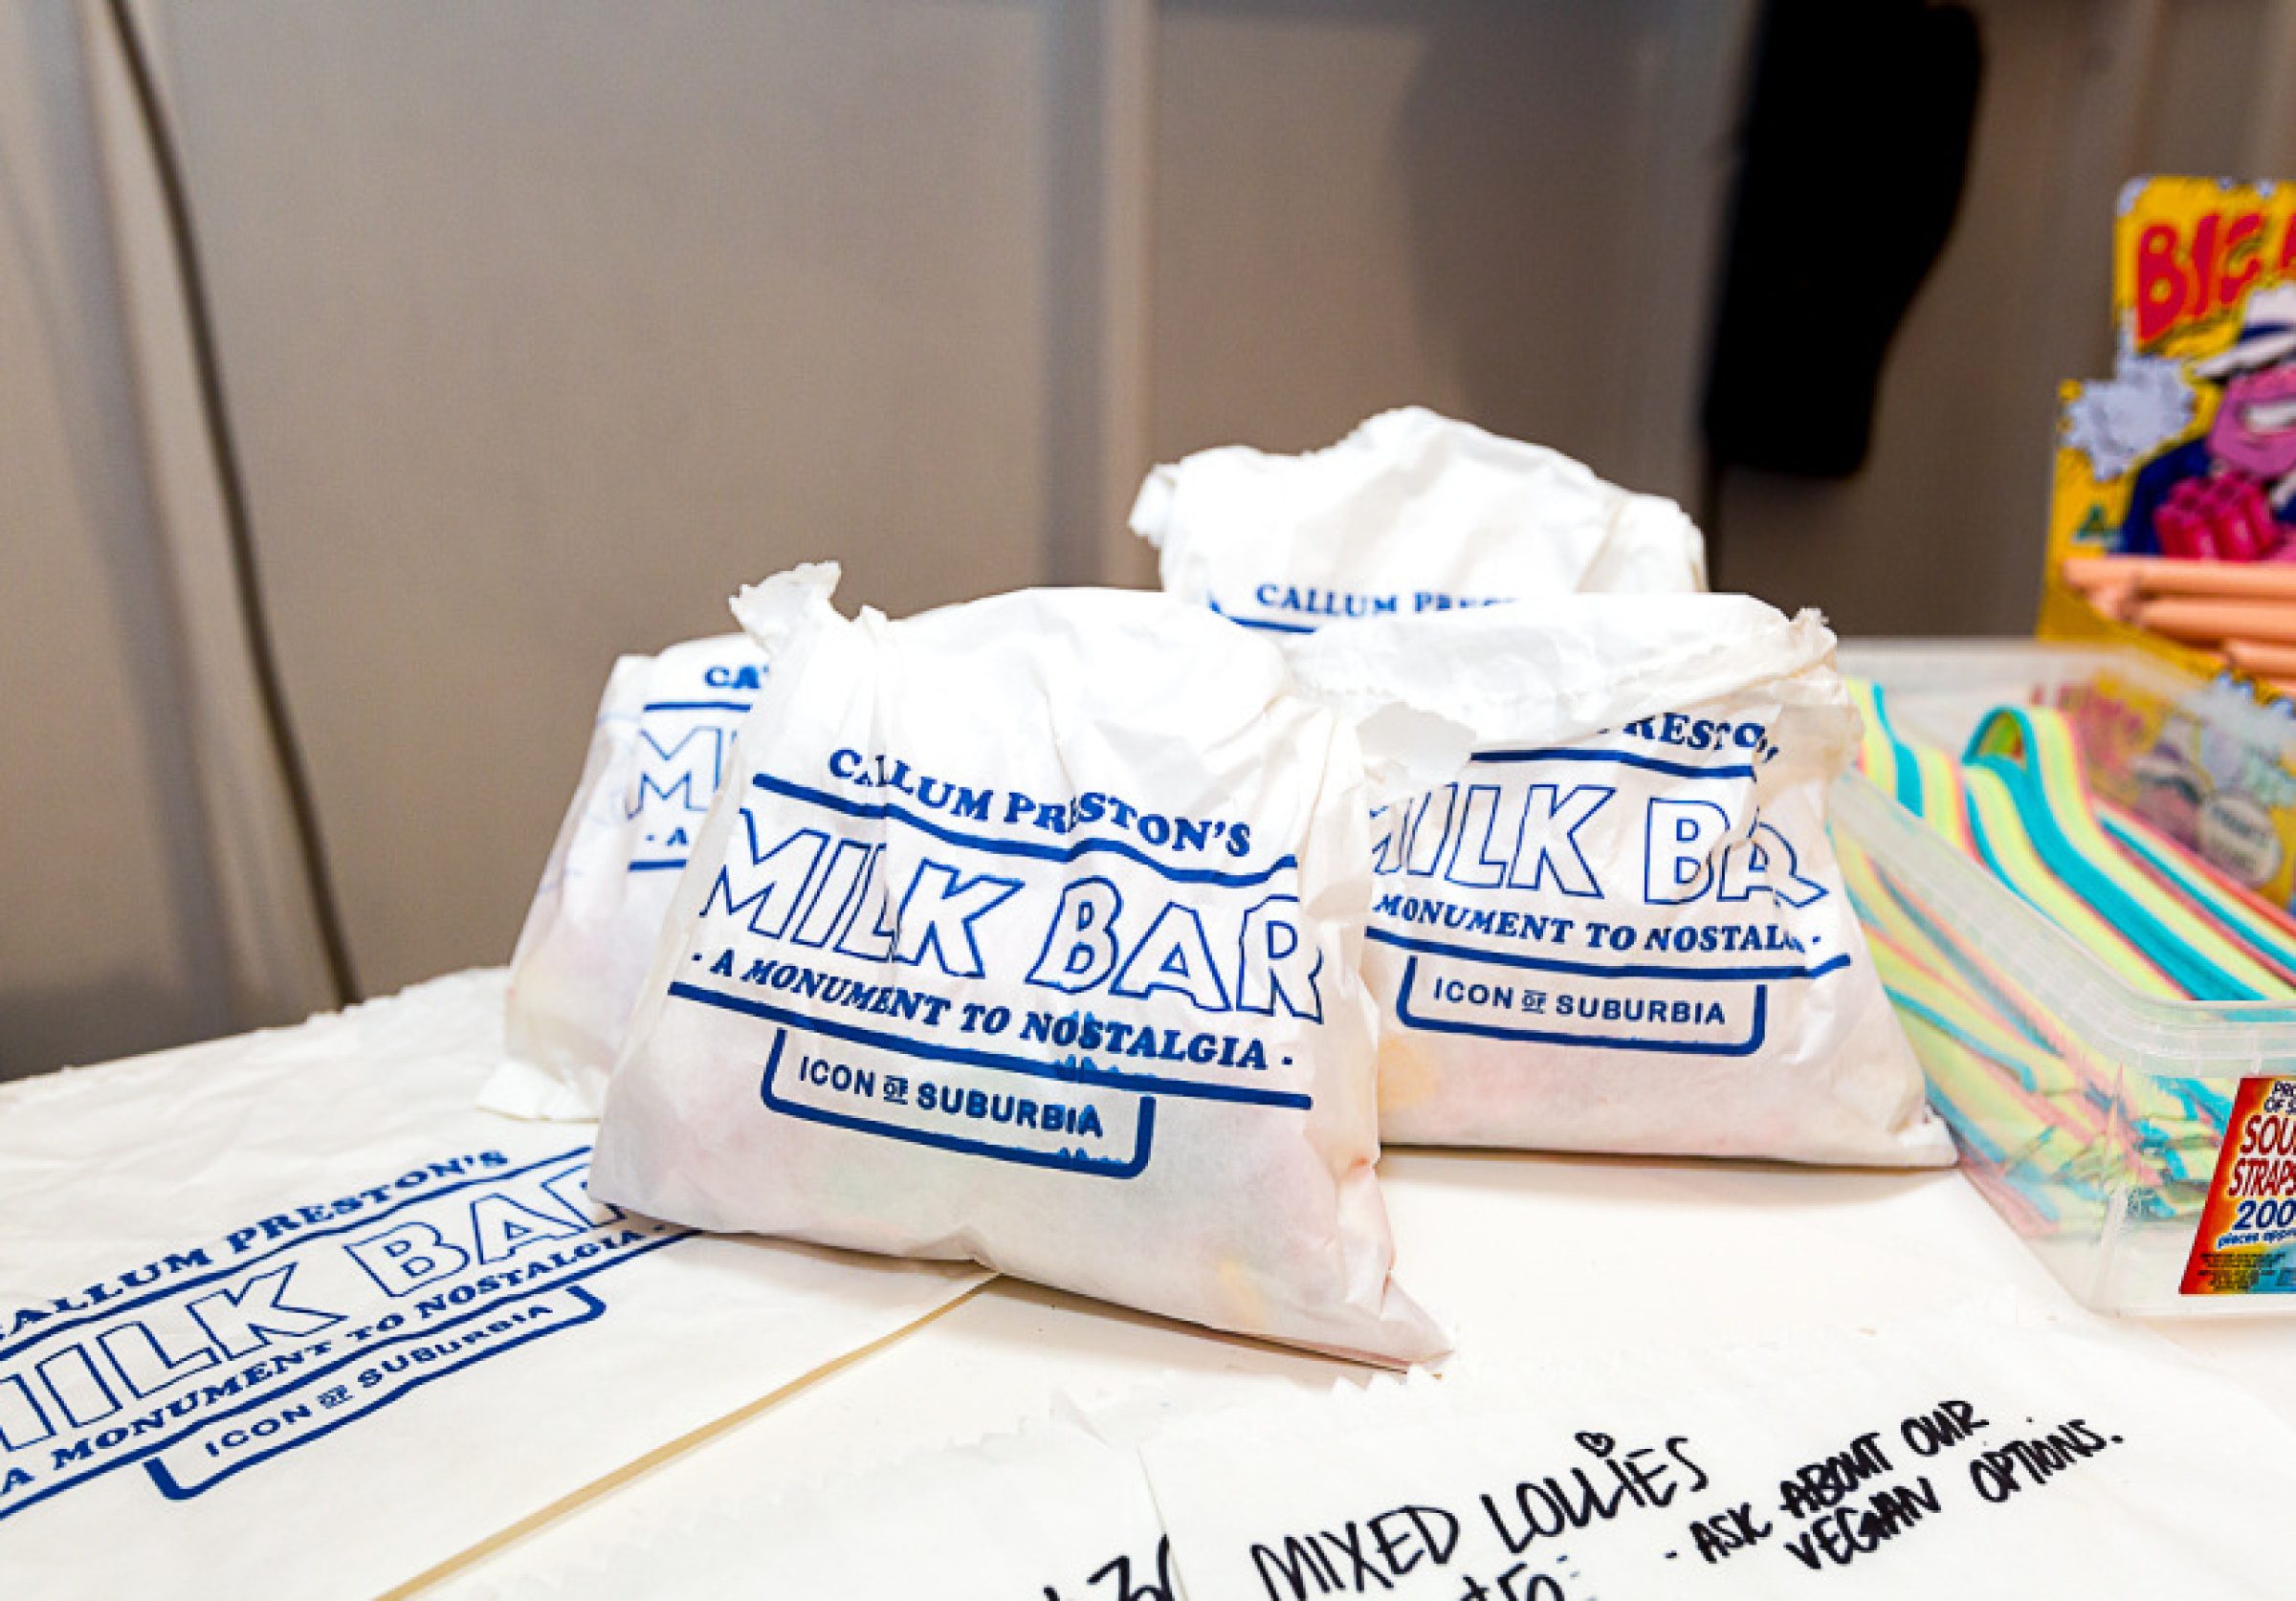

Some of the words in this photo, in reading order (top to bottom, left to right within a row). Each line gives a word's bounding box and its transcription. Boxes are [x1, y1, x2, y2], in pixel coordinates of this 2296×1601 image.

[1254, 582, 1398, 617] CALLUM
[703, 664, 769, 690] CA
[1004, 791, 1250, 857] PRESTON'S
[699, 807, 1027, 978] MILK
[1025, 876, 1324, 1024] BAR
[1372, 893, 1575, 945] MONUMENT
[1585, 921, 1639, 952] TO
[1645, 922, 1806, 954] NOSTAL
[710, 949, 736, 974] A
[740, 958, 952, 1028] MONUMENT
[959, 1002, 1010, 1035] TO
[1019, 1012, 1269, 1071] NOSTALGIA
[1433, 976, 1513, 1009] ICON
[1521, 988, 1547, 1015] OF
[1556, 992, 1726, 1026] SUBURBIA
[798, 1056, 874, 1098] ICON
[883, 1075, 909, 1105] OF
[916, 1082, 1103, 1138] SUBURBIA
[2239, 1114, 2296, 1157] SOU
[0, 1245, 214, 1338] ALLUM
[224, 1150, 509, 1257] PRESTON'S
[2231, 1199, 2296, 1230] 200
[51, 1339, 335, 1471] MONUMENT
[346, 1311, 407, 1341] TO
[413, 1230, 646, 1320] NOSTALGIA
[205, 1405, 312, 1458] ICON
[357, 1305, 554, 1388] SUBURBIA
[1250, 1504, 1461, 1601] MIXED
[1480, 1431, 1709, 1554] LOLLIES
[1689, 1502, 1773, 1566] ASK
[1778, 1431, 1893, 1519] ABOUT
[1900, 1398, 1989, 1458] OUR
[1785, 1475, 1942, 1570] VEGAN
